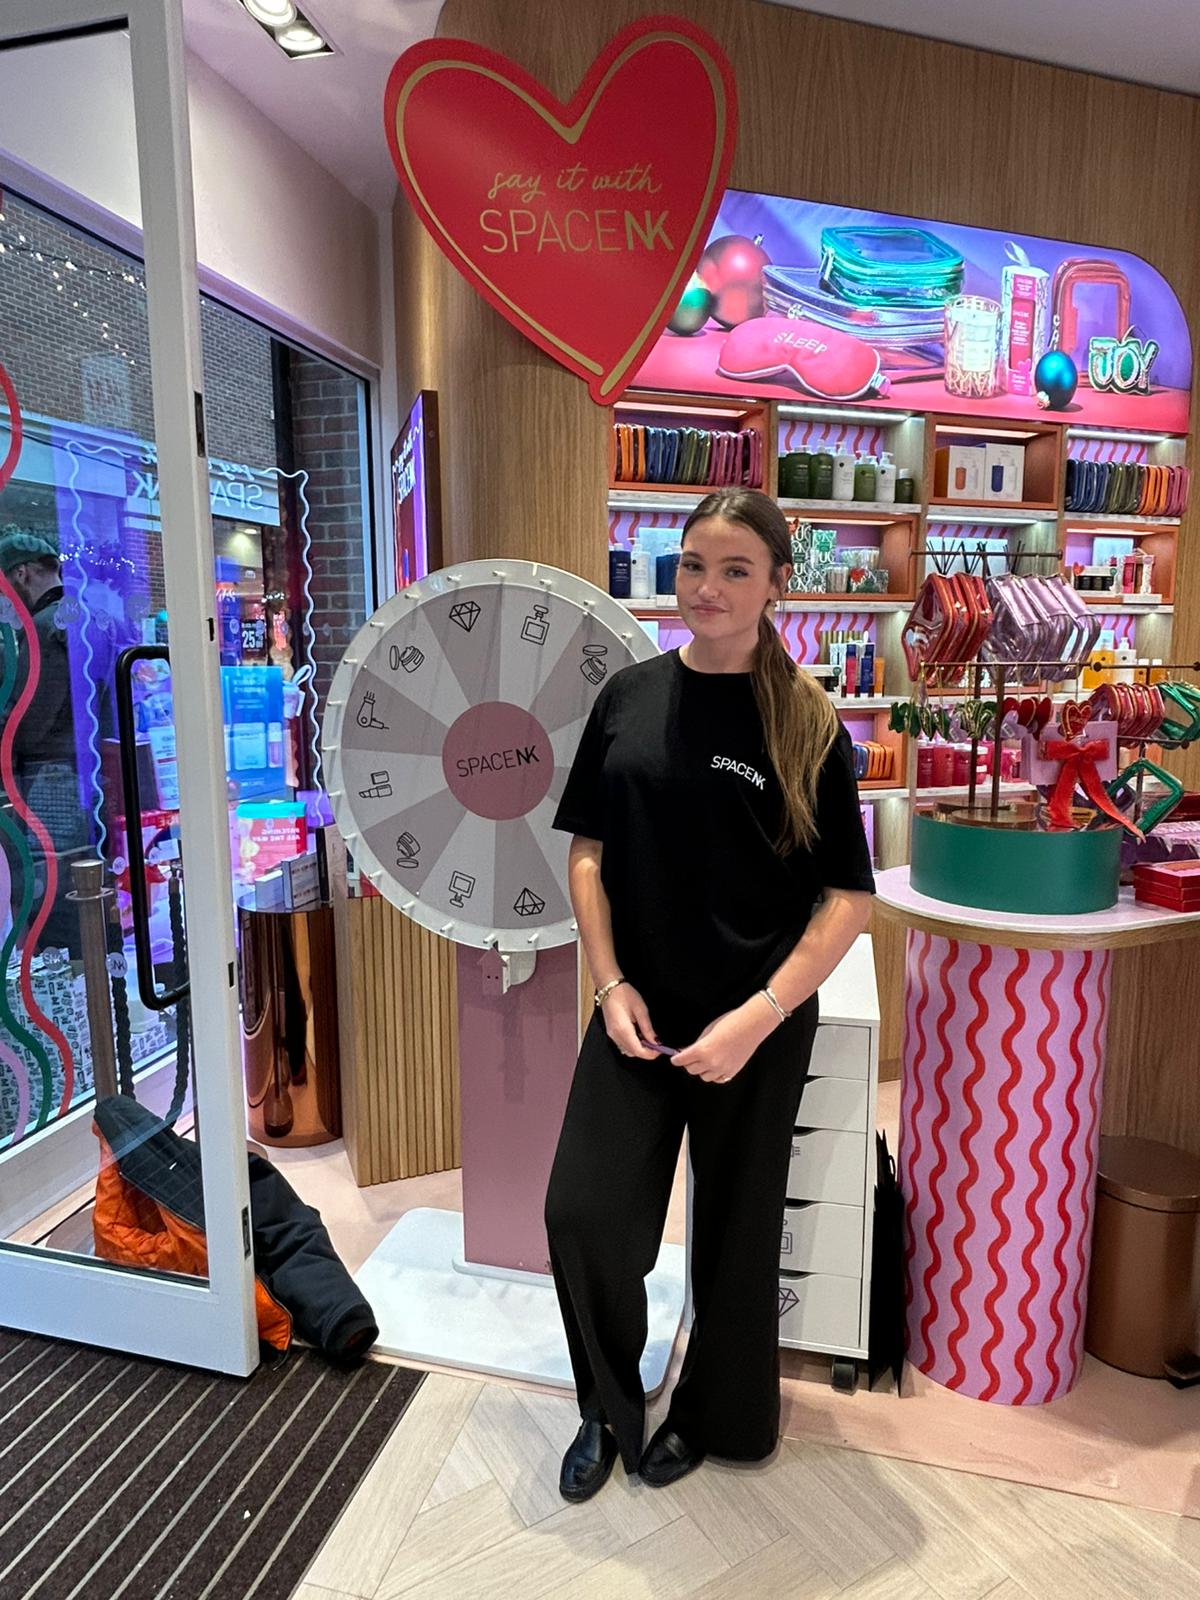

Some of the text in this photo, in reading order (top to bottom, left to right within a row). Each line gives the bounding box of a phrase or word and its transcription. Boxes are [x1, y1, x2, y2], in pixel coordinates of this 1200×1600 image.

[487, 162, 662, 202] say it with
[773, 331, 828, 354] SLEEP
[1088, 336, 1160, 395] JOY
[456, 745, 540, 778] SPACENK
[710, 755, 766, 791] SPACENK
